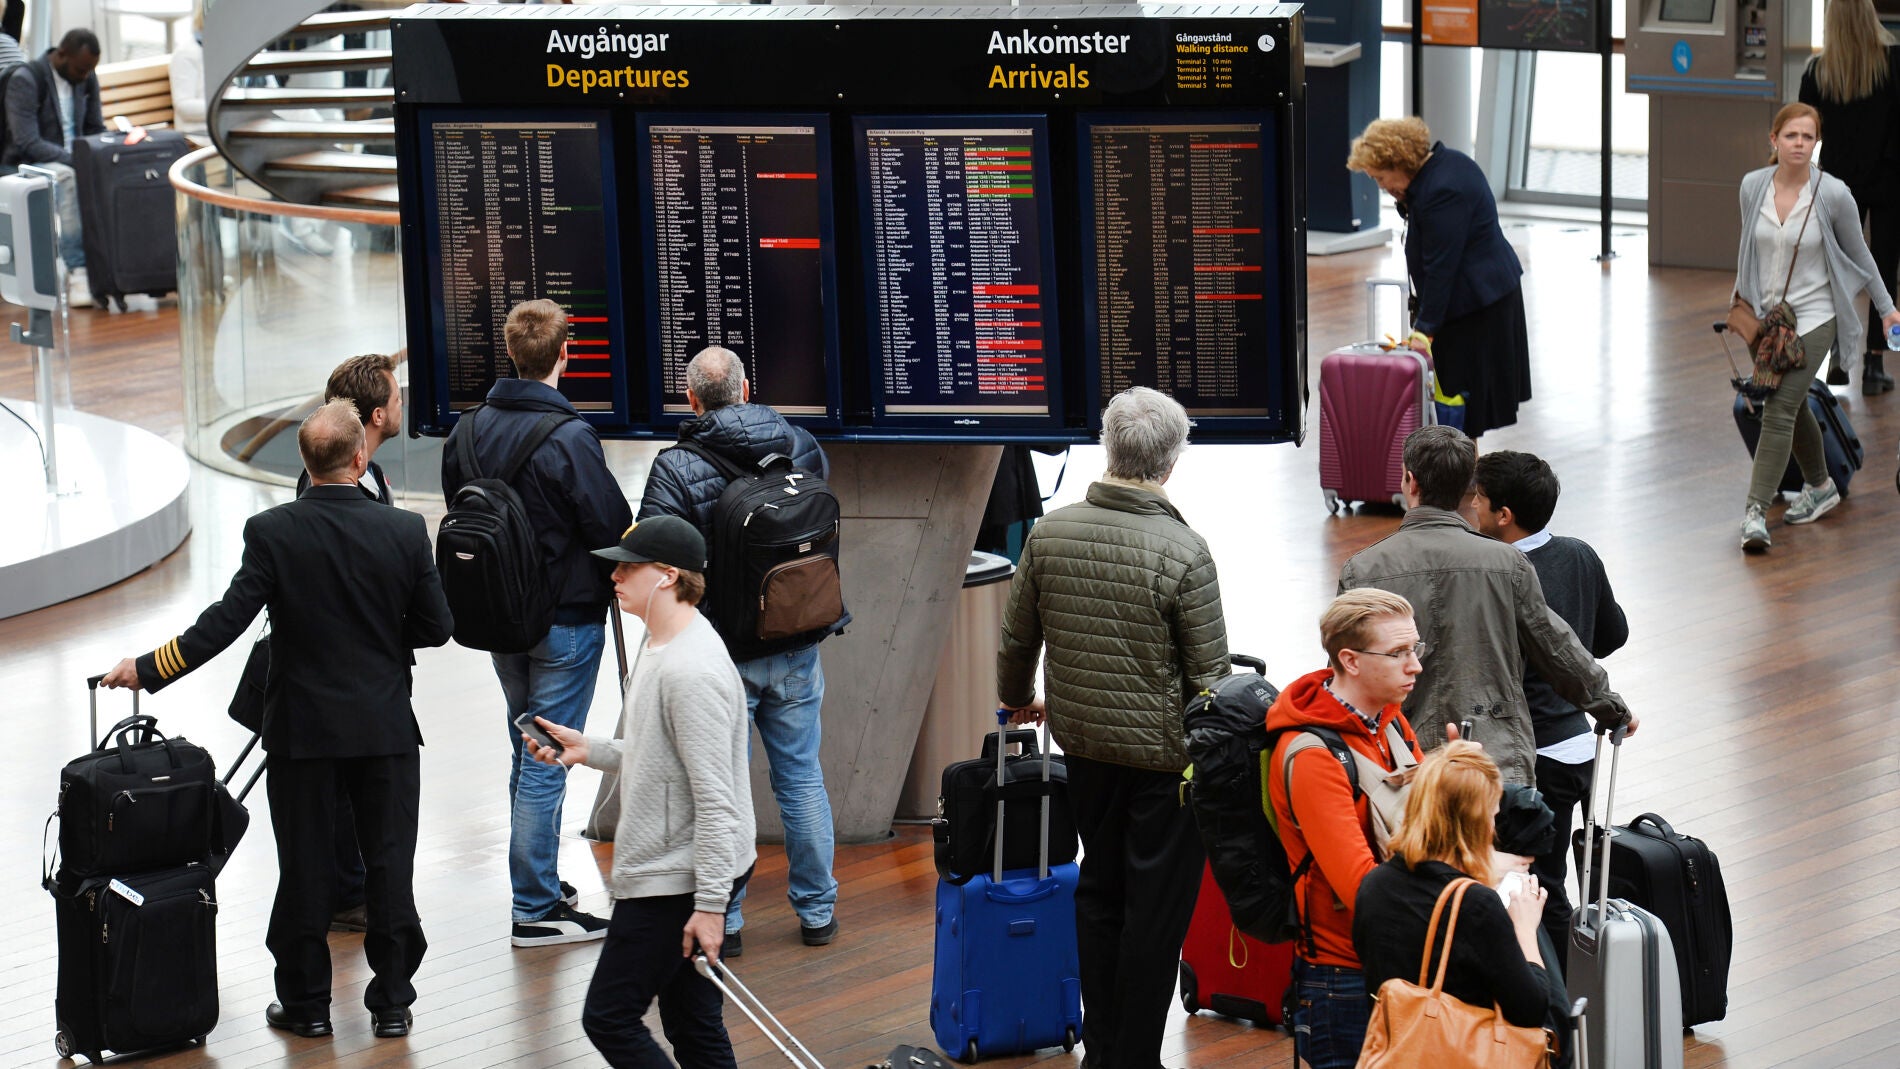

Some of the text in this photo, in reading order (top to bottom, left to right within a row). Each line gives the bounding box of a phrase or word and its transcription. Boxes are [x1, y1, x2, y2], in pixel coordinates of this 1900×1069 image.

[546, 26, 670, 59] Avgångar
[987, 29, 1130, 54] Ankomster
[1176, 33, 1232, 44] Gångavstånd
[1176, 44, 1248, 54] Walking distance
[546, 64, 690, 94] Departures
[988, 64, 1090, 88] Arrivals
